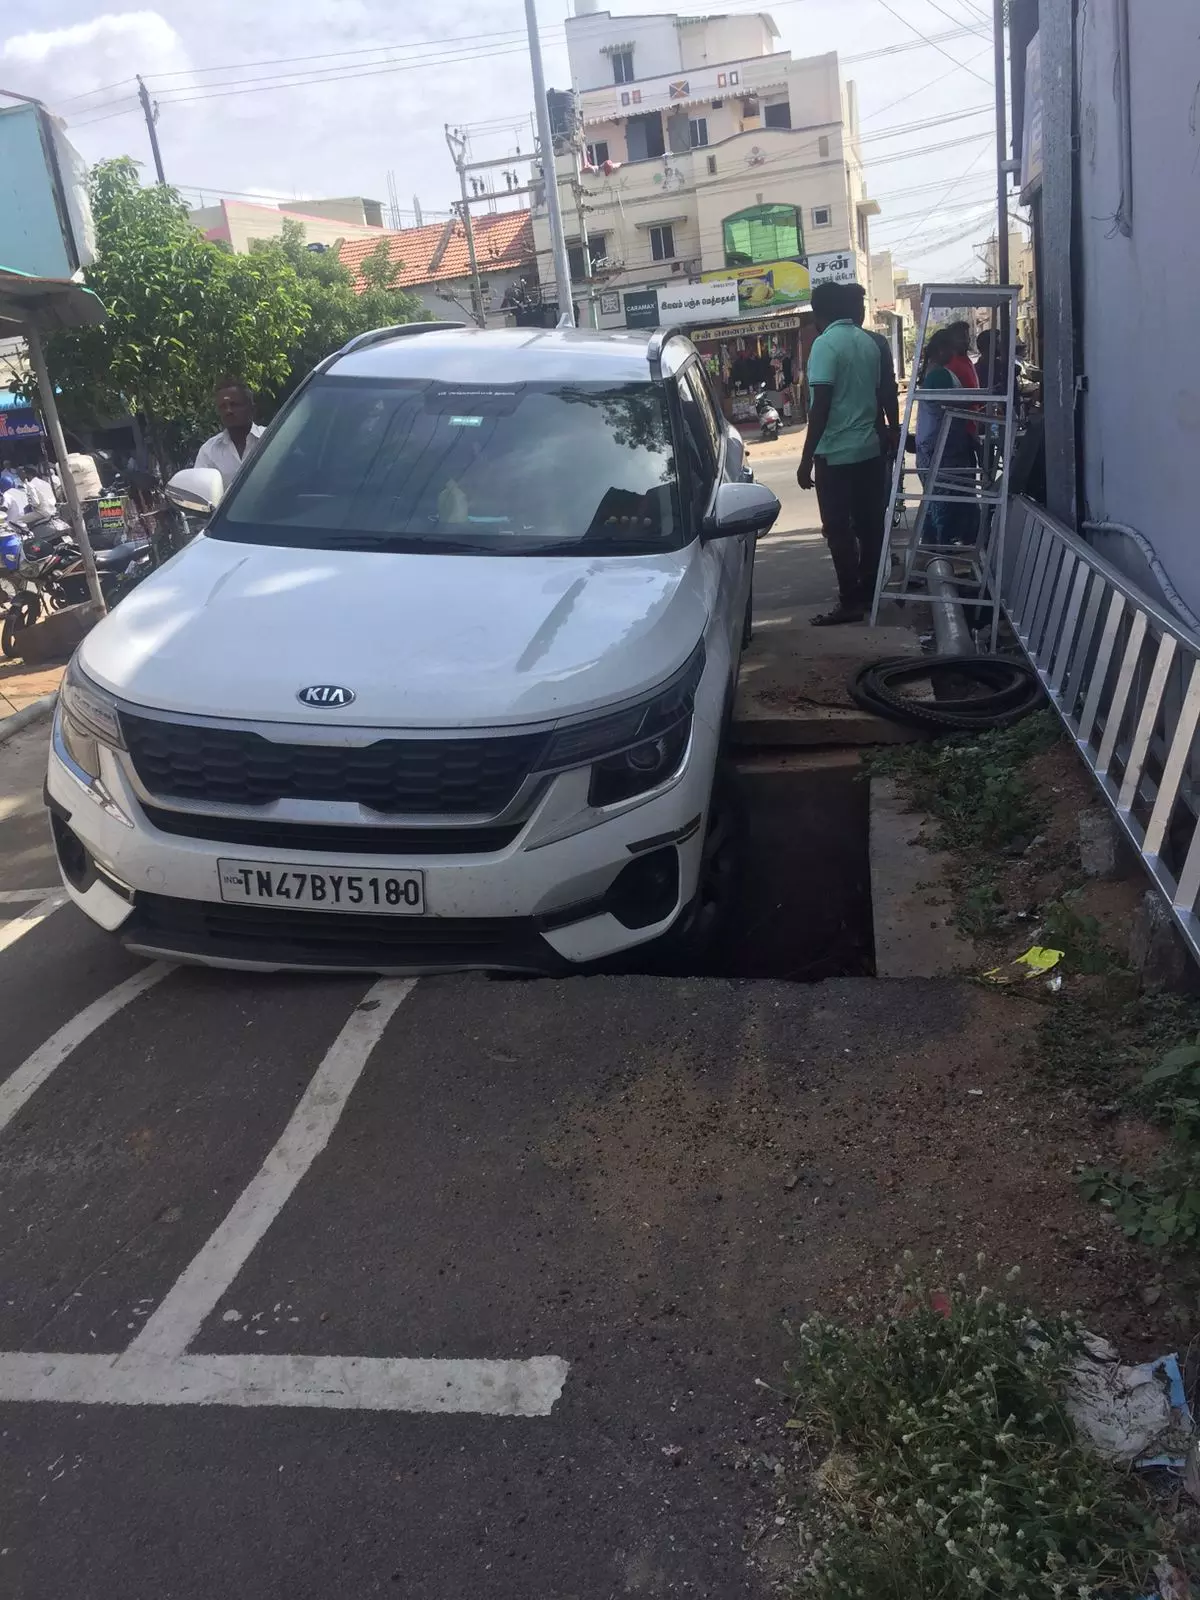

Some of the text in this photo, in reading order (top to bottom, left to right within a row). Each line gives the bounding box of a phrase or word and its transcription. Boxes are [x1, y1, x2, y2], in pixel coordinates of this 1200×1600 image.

[816, 254, 850, 273] சன்
[626, 303, 655, 312] CARAMAX
[306, 687, 345, 703] KIA
[239, 868, 419, 906] TN47BY5180
